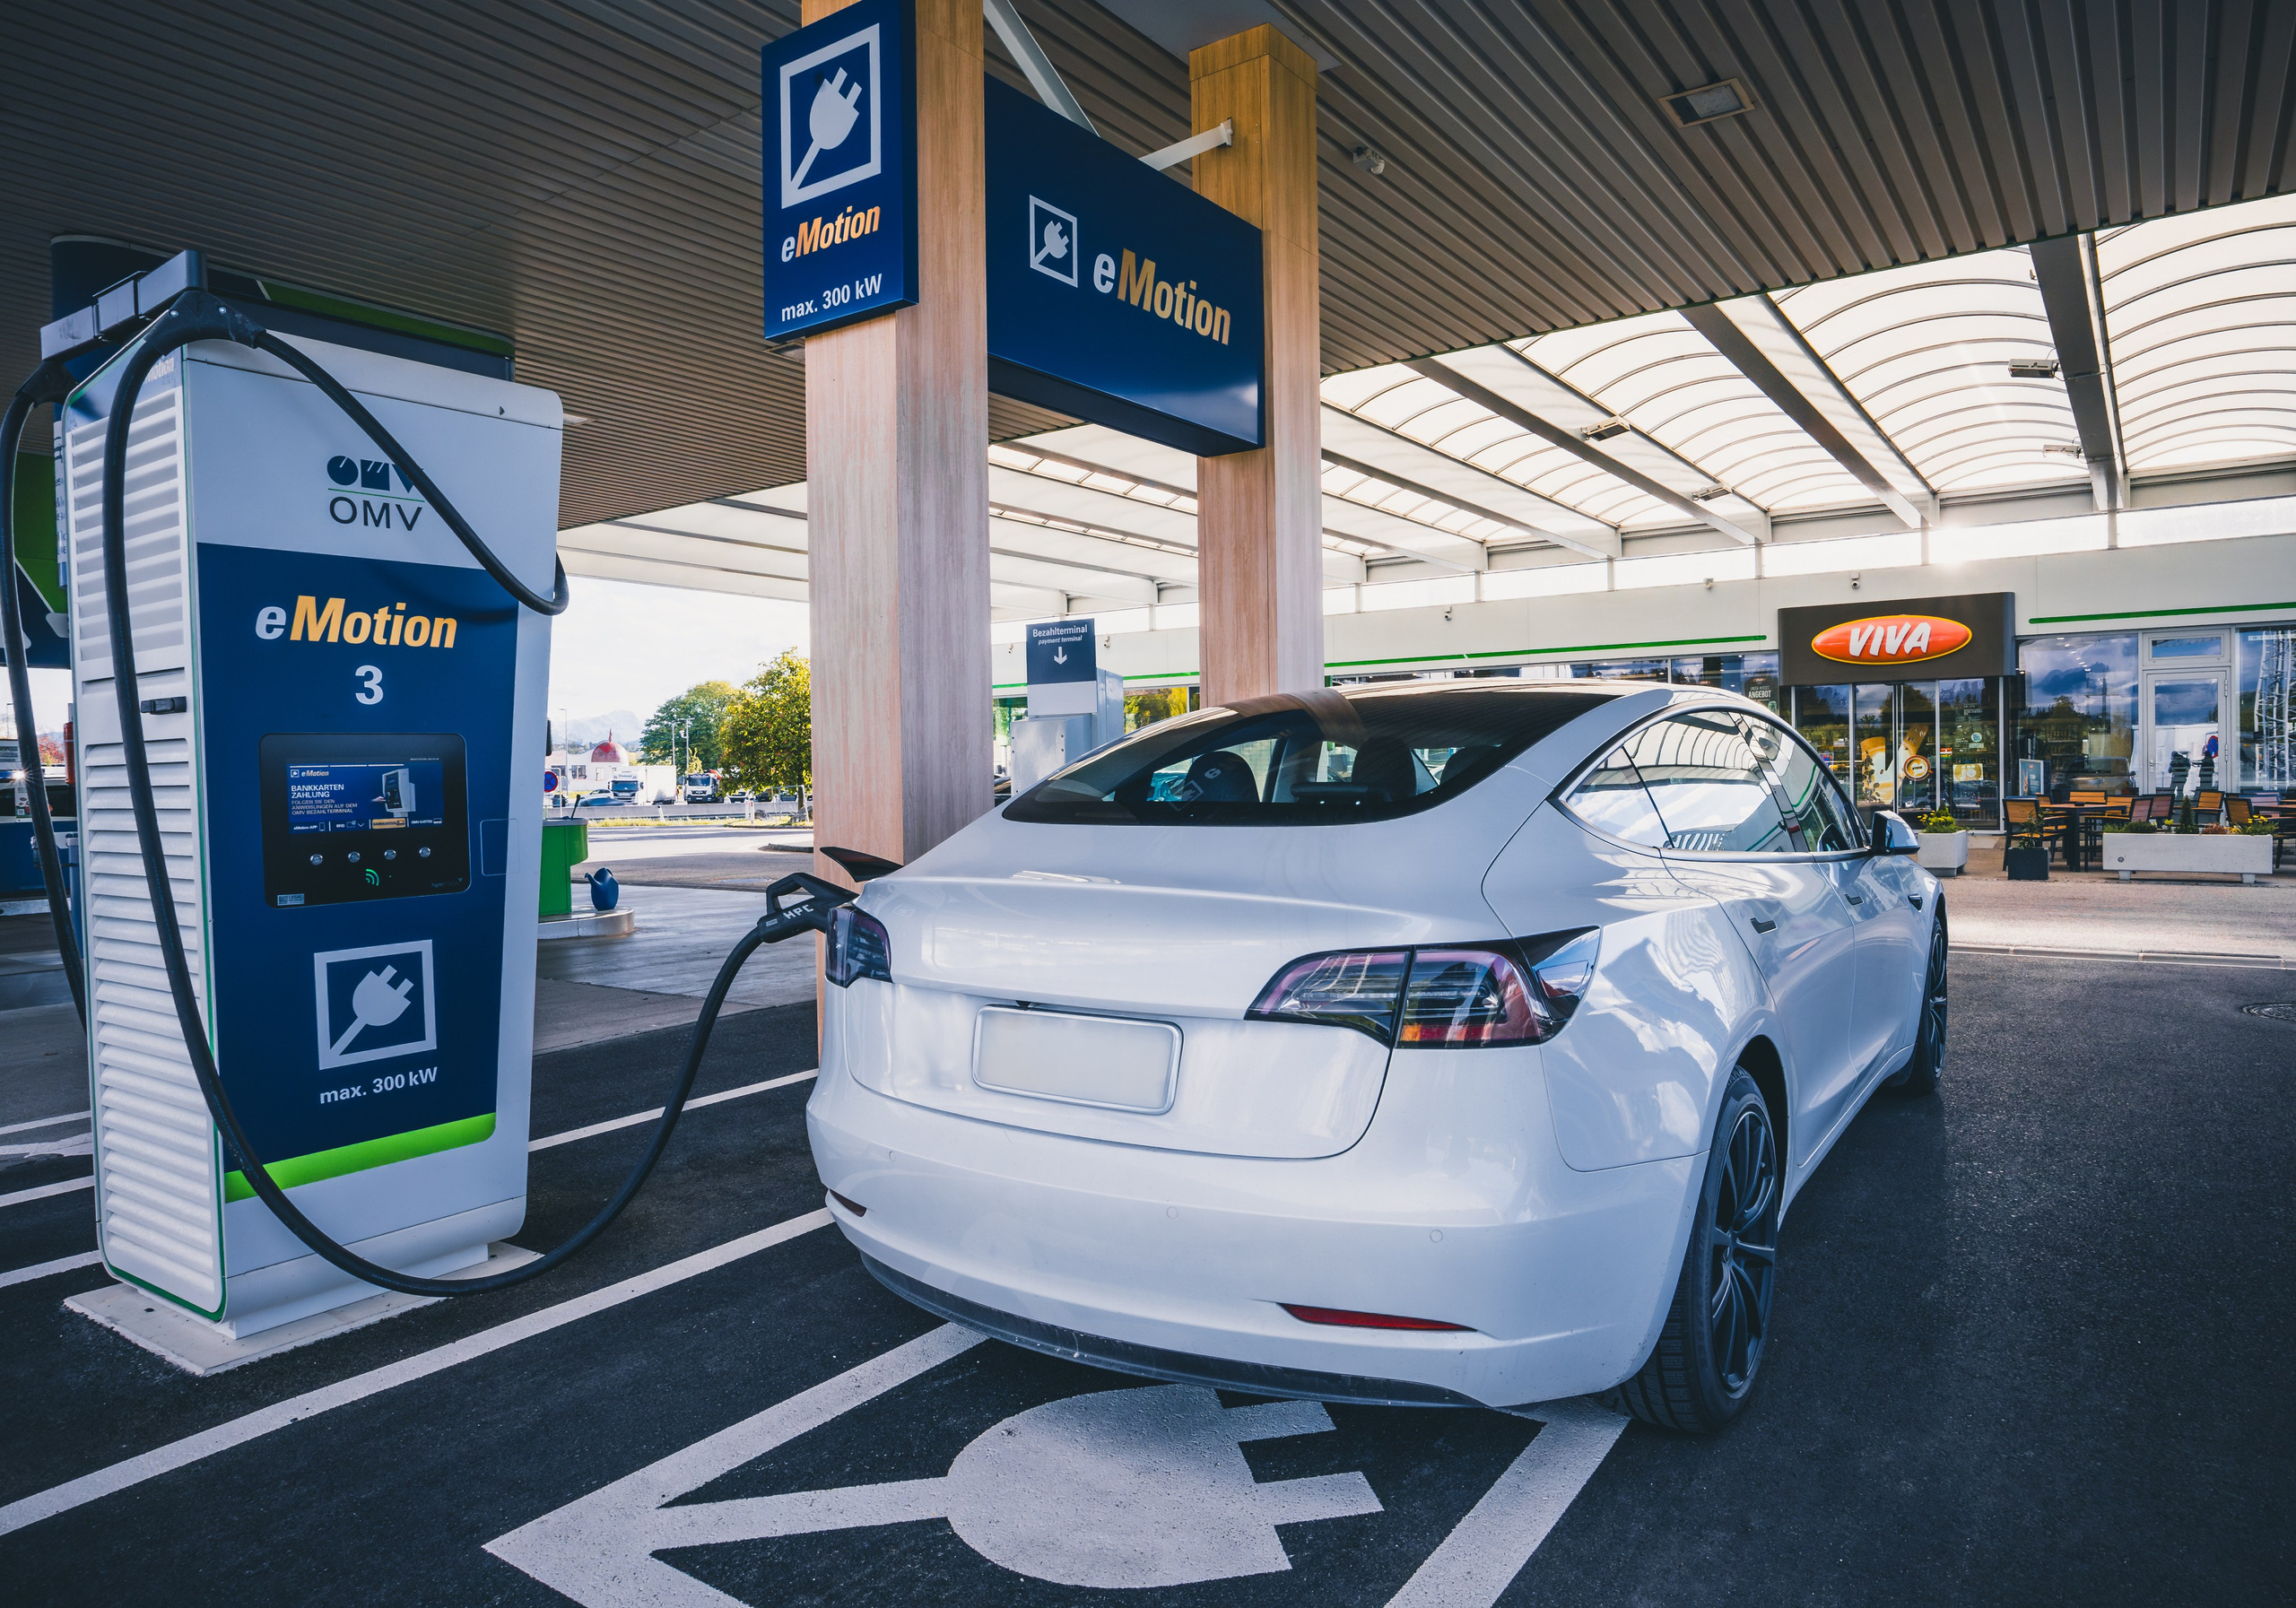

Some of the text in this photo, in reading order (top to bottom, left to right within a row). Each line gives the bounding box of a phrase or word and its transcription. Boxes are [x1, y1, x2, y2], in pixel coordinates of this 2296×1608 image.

[781, 204, 881, 264] eMotion
[782, 274, 883, 322] max. 300 kW
[1093, 248, 1231, 345] eMotion
[329, 496, 423, 532] OMV
[256, 595, 457, 648] eMotion
[1032, 624, 1088, 638] Bezahlterminal
[1038, 635, 1083, 646] payment terminal
[1848, 621, 1932, 657] VIVA
[355, 665, 384, 705] 3
[1748, 690, 1772, 699] ANGEBOT
[301, 769, 329, 778] eMotion
[1961, 765, 1977, 781] jö
[291, 784, 344, 792] BANKKARTEN
[291, 791, 330, 799] ZAHLUNG
[783, 904, 814, 920] HPC
[319, 1066, 438, 1104] max. 300 kW
